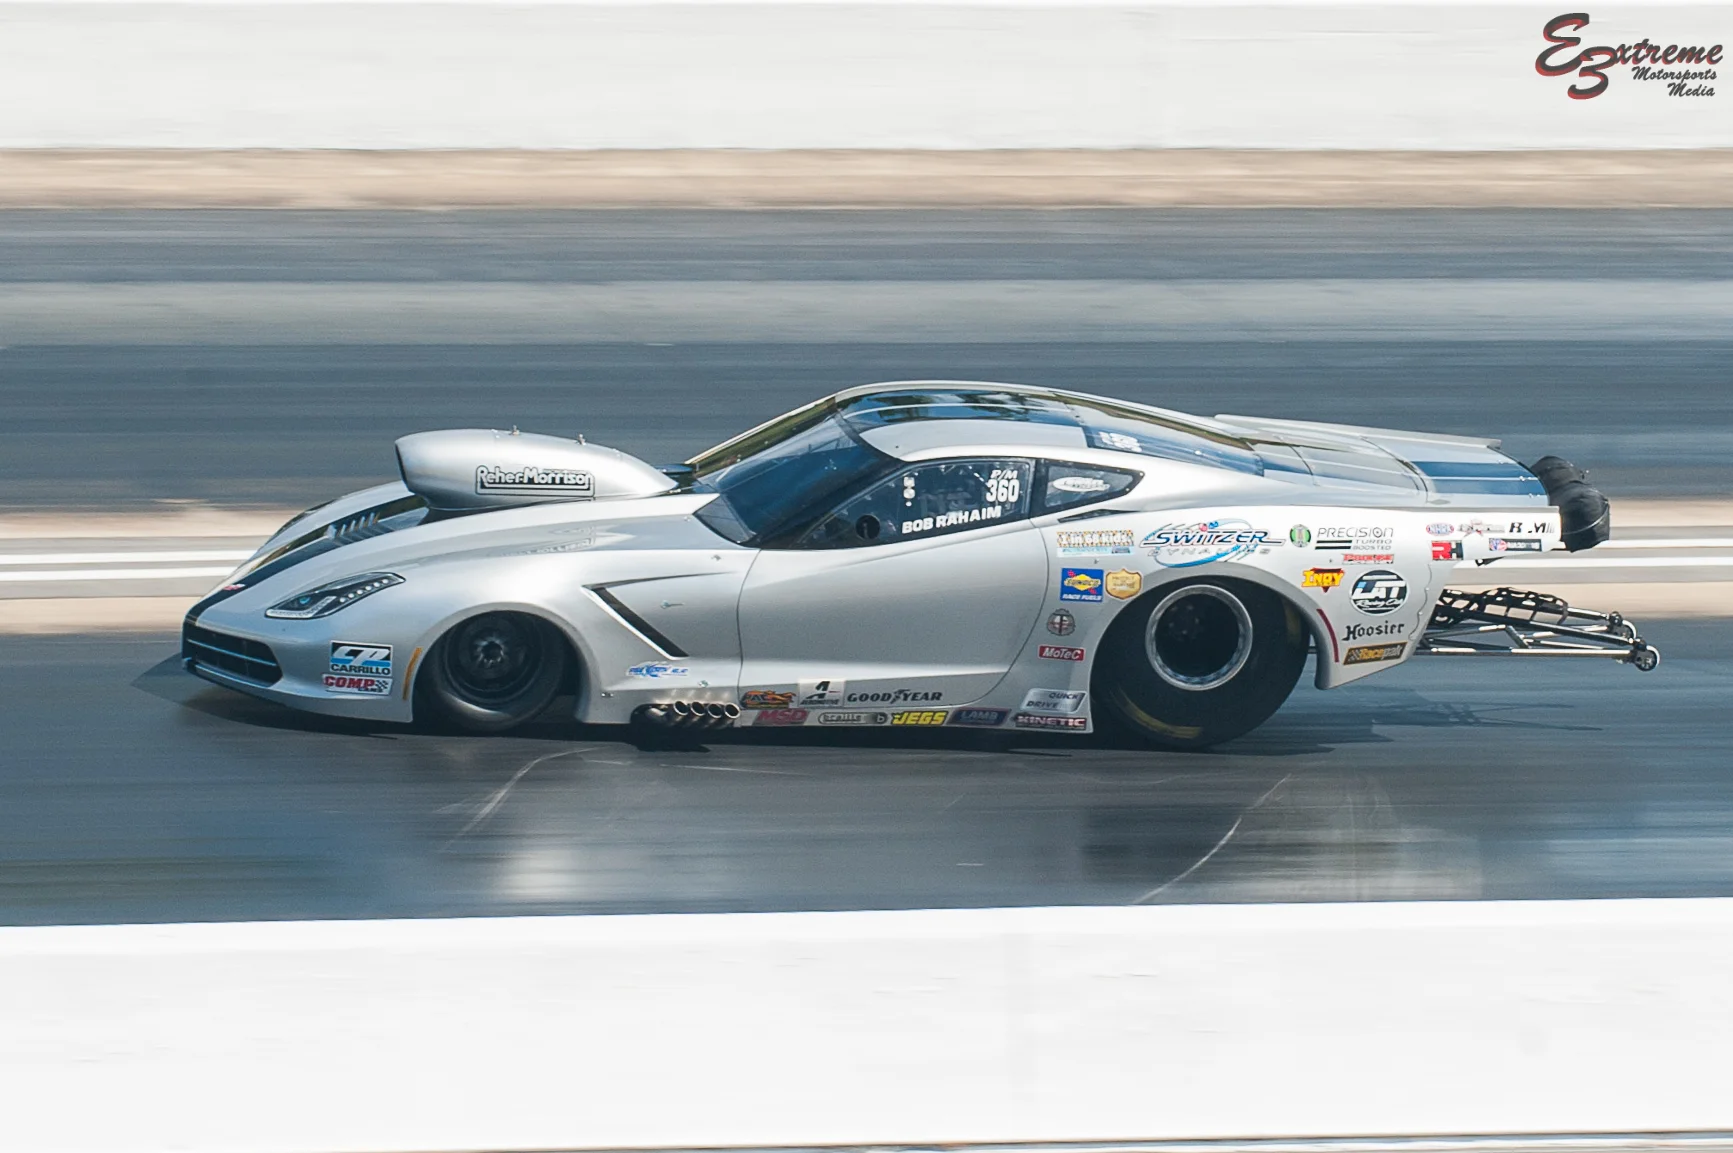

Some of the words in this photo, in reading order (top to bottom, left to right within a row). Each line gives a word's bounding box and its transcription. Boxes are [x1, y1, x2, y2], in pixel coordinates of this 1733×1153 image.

[990, 469, 1018, 480] P/M
[986, 479, 1020, 502] 360
[902, 519, 934, 534] BOB
[936, 505, 1002, 528] RAHAIM
[1142, 529, 1284, 545] SWITZER
[1317, 527, 1394, 538] PRECISION
[1302, 569, 1344, 588] INDY
[1341, 620, 1405, 641] Hoosier
[332, 645, 390, 666] CP
[1043, 647, 1082, 660] MoTeC
[331, 664, 391, 675] CARRILLO
[324, 676, 375, 688] COMP
[1049, 692, 1079, 700] QUICK
[758, 708, 809, 723] MSD
[892, 711, 947, 725] JEGS
[961, 710, 998, 720] LAMB
[1017, 715, 1085, 727] KINETIC
